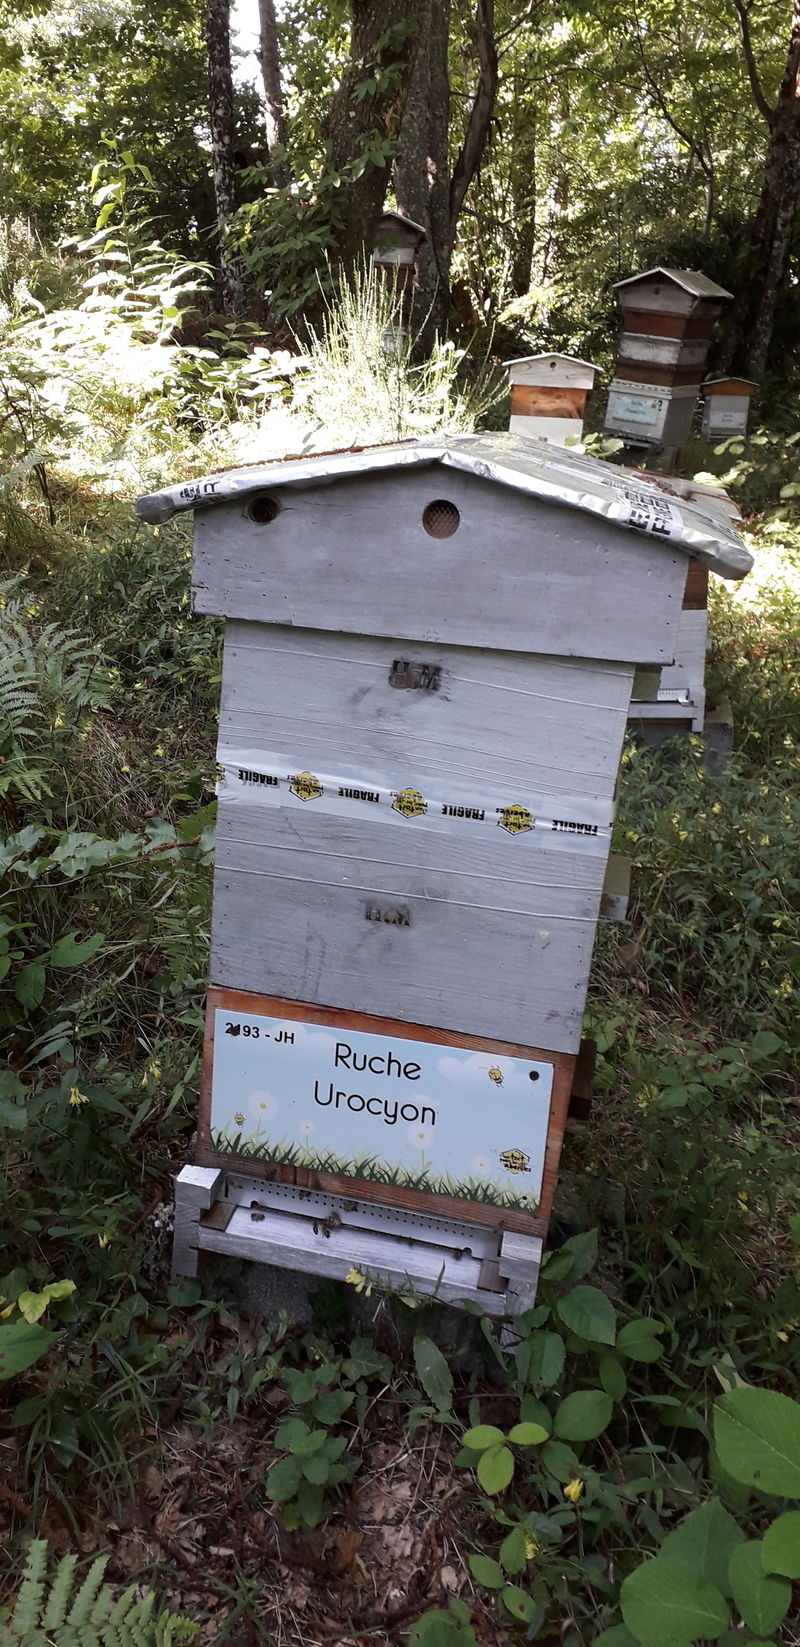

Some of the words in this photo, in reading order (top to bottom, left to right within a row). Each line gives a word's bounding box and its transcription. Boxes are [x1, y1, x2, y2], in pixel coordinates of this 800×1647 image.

[238, 769, 278, 786] FRAGILE
[338, 787, 380, 803] FRAGILE
[441, 804, 485, 821] FRAGILE
[274, 1030, 295, 1045] JH
[334, 1042, 422, 1081] Ruche
[313, 1080, 436, 1125] Urocyon
